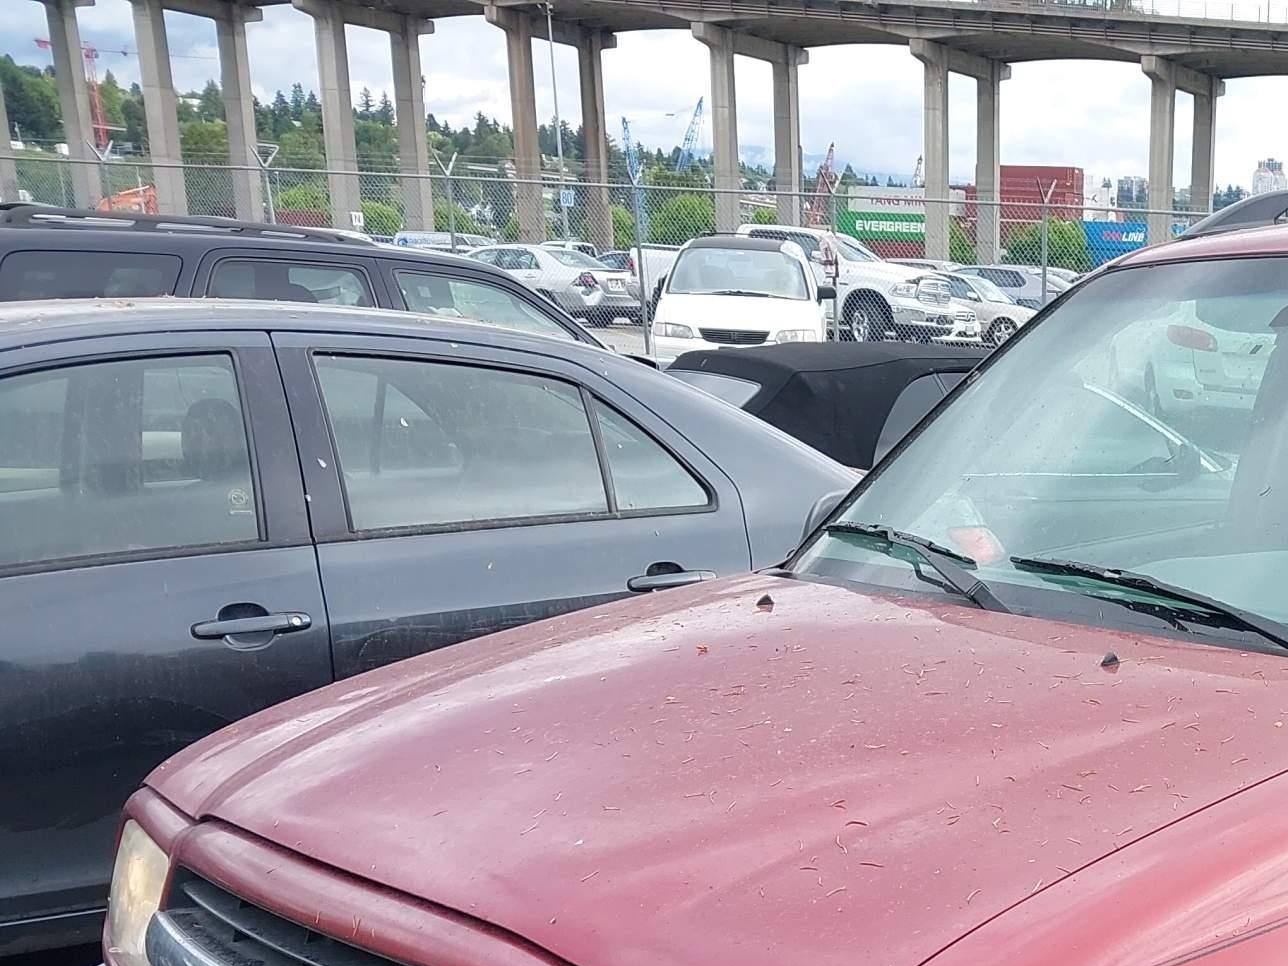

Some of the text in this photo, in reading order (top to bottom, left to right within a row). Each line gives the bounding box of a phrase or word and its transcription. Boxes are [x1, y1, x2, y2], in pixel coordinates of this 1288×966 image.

[561, 191, 573, 205] 80
[903, 195, 925, 207] MIN
[855, 220, 925, 233] EVERGREEN
